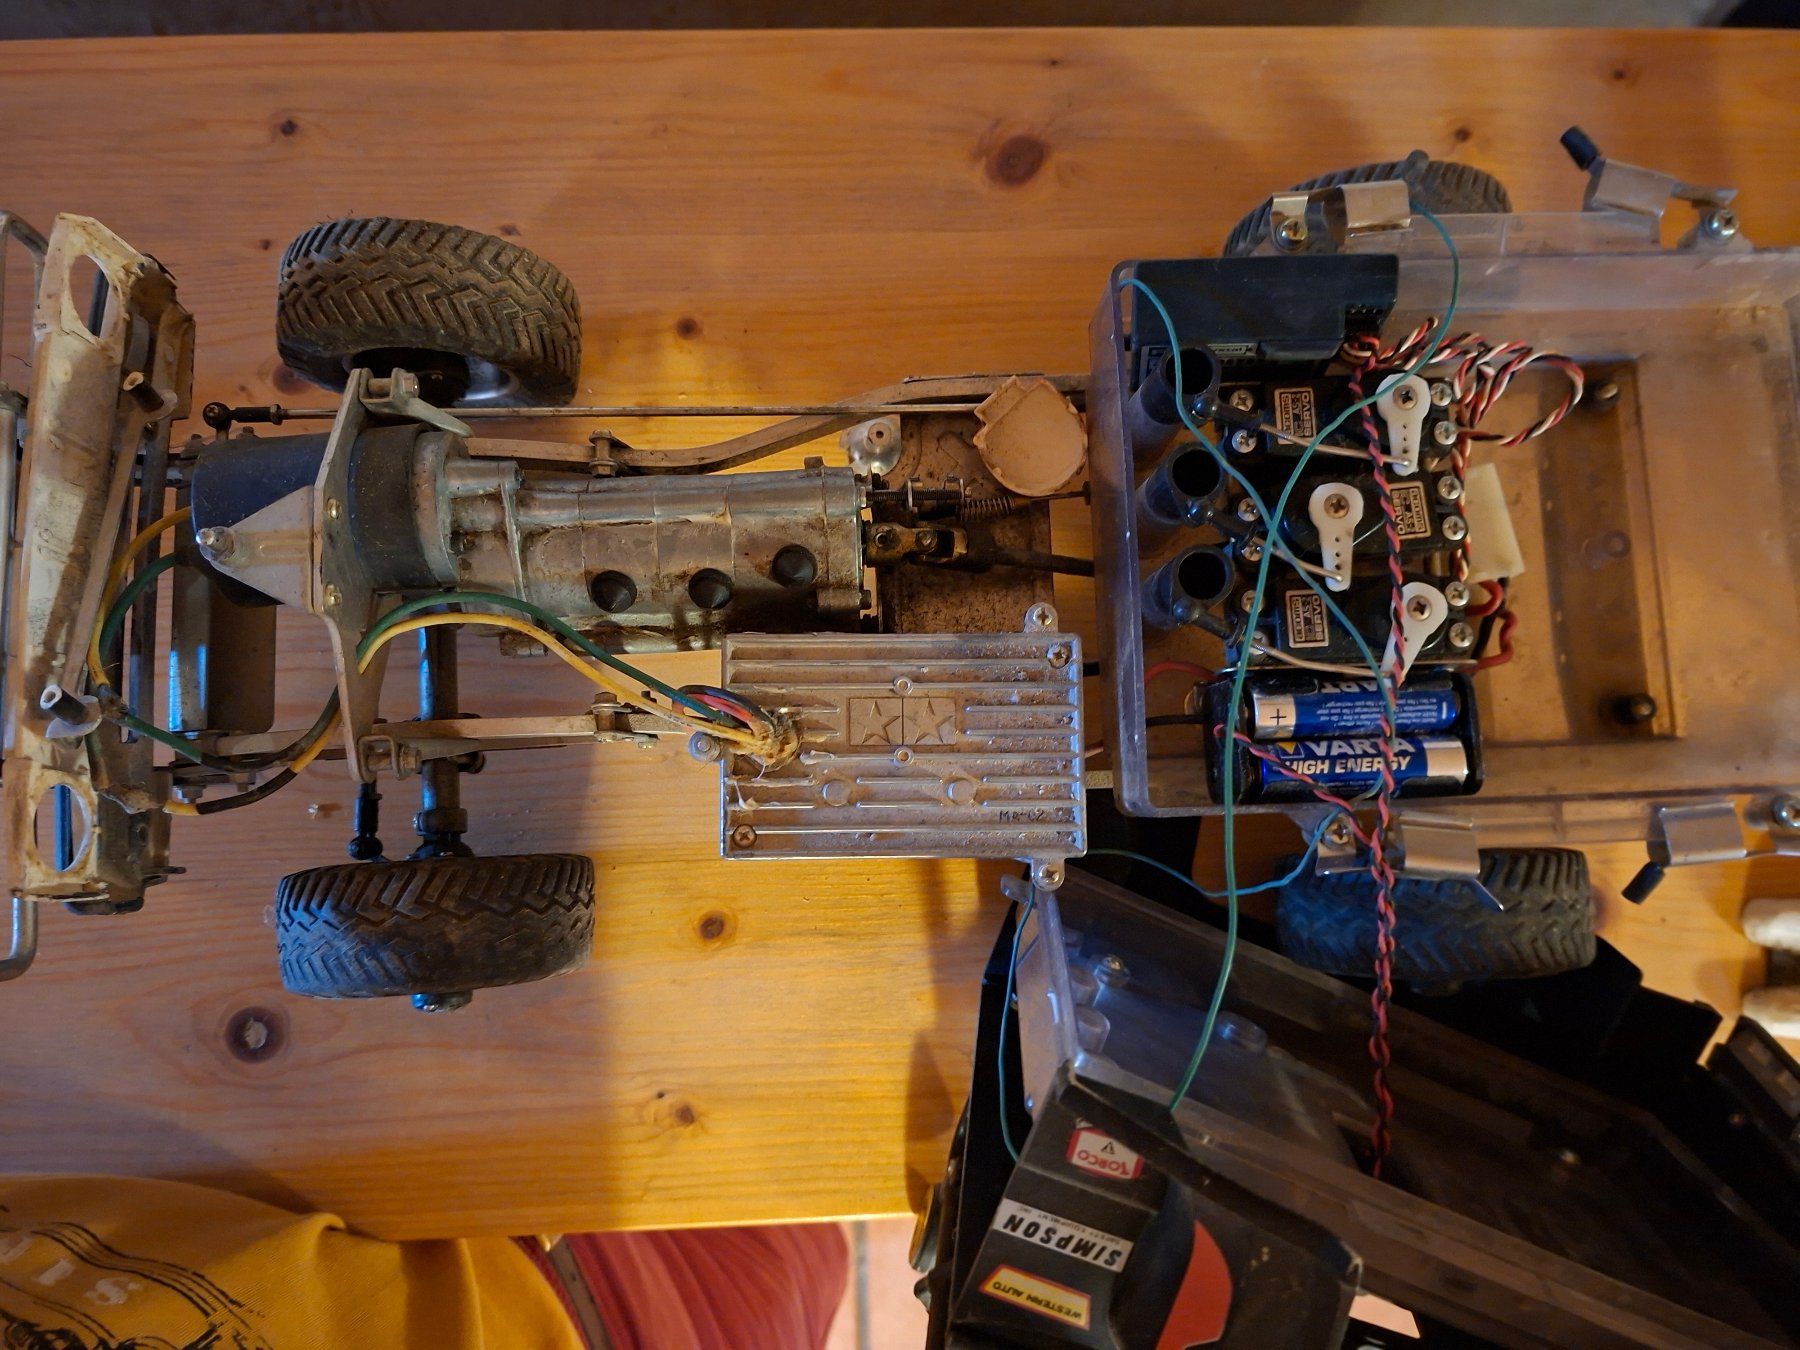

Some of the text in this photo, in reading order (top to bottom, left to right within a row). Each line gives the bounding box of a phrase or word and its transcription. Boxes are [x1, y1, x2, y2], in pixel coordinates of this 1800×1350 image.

[1302, 392, 1312, 437] SERVO
[1312, 595, 1324, 641] SERVO
[1077, 1149, 1131, 1176] TORCO
[1002, 1213, 1123, 1267] SIMPSON
[991, 1280, 1082, 1321] WESTERN AUTO
